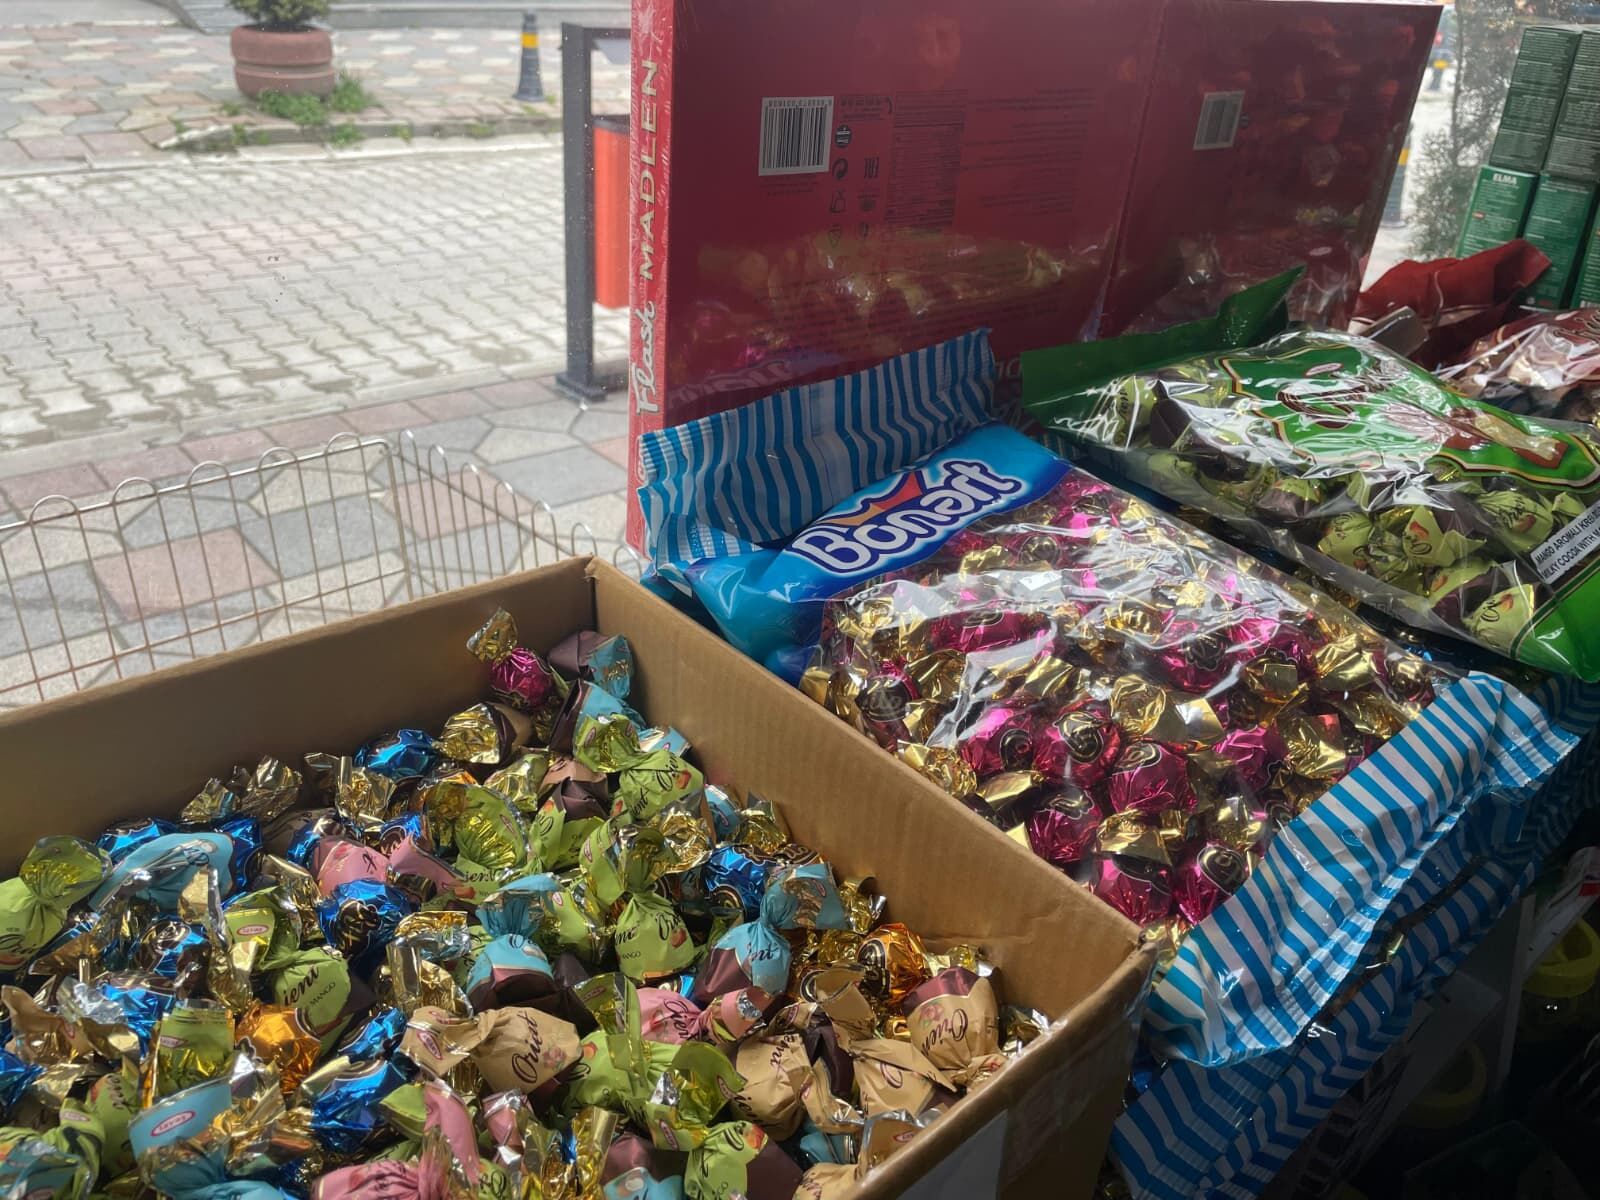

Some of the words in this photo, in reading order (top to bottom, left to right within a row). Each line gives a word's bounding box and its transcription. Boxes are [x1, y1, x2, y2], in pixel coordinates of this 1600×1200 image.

[639, 59, 658, 281] MADLEN
[1492, 173, 1517, 185] ELMA
[632, 300, 659, 416] Flash
[1557, 547, 1581, 566] COCOA
